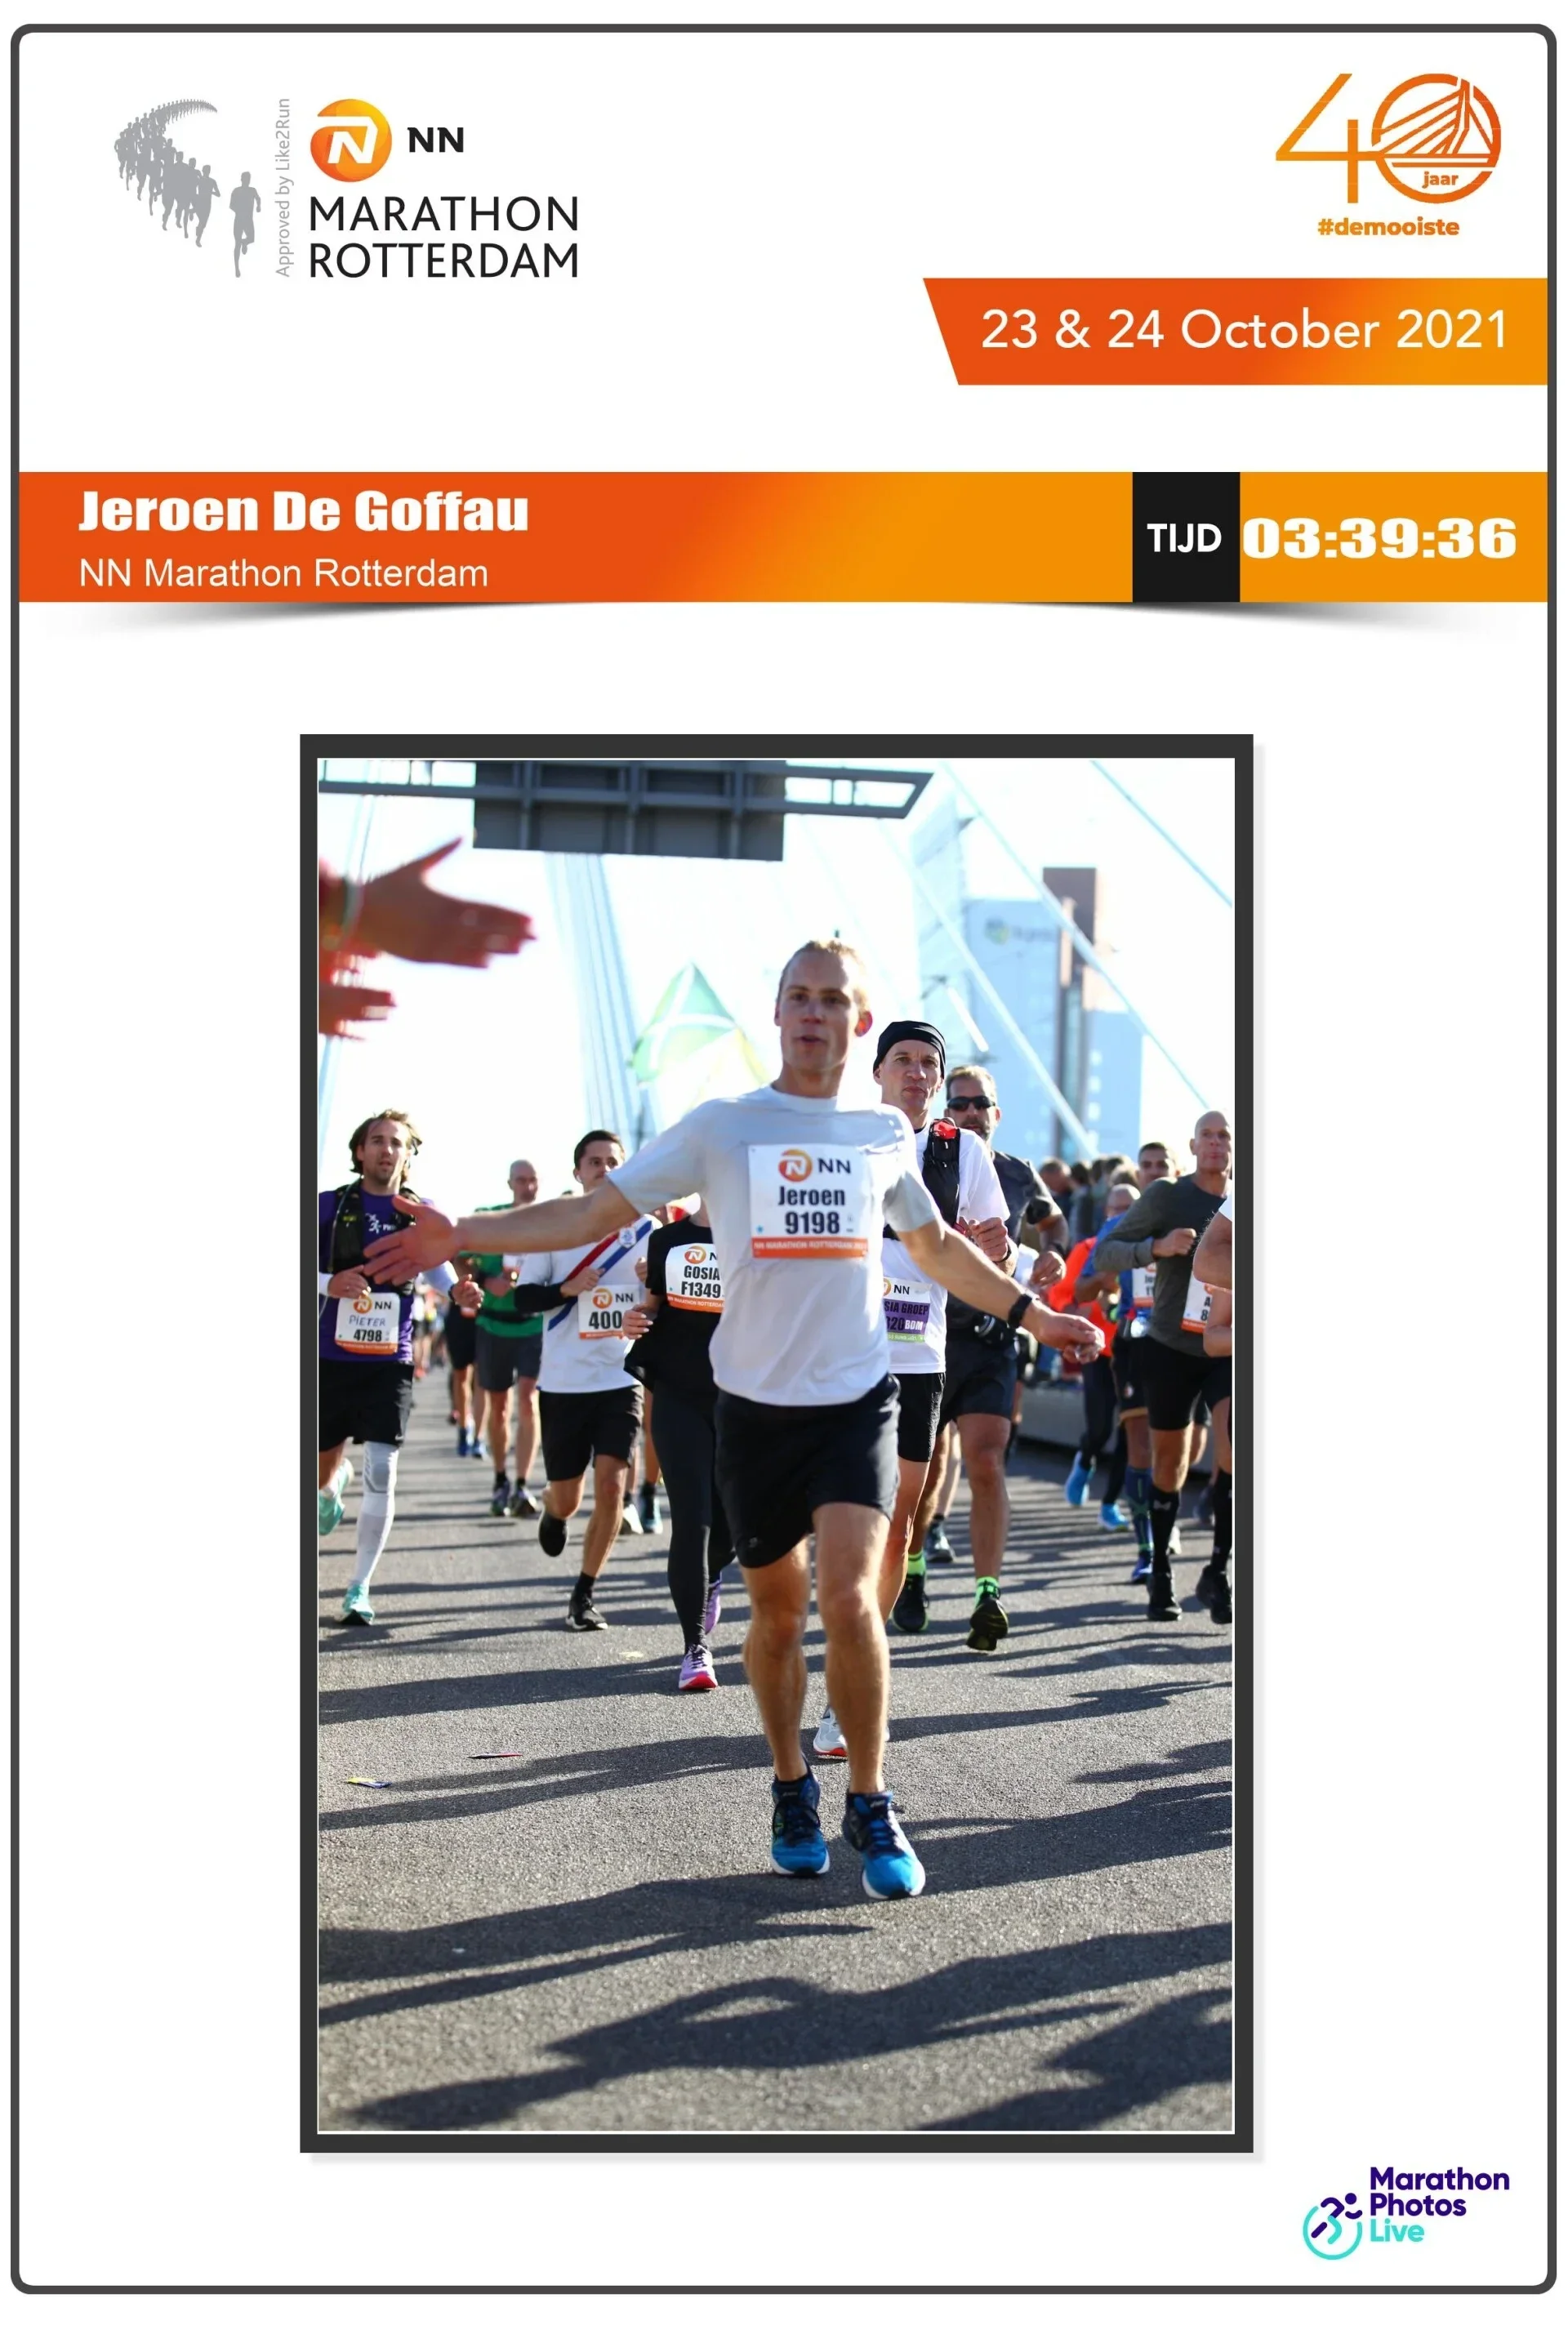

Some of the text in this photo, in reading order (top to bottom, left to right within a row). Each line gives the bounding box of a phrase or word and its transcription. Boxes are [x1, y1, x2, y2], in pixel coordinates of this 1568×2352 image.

[817, 1158, 851, 1174] NN
[778, 1186, 846, 1206] Jeroen
[786, 1211, 840, 1234] 9198
[684, 1265, 720, 1281] GOSIA
[681, 1281, 721, 1298] F1349
[893, 1285, 911, 1295] NN
[375, 1301, 392, 1310] NN
[615, 1293, 634, 1303] NN
[901, 1303, 929, 1316] GROEP
[588, 1310, 622, 1330] 400
[353, 1329, 382, 1342] 4798
